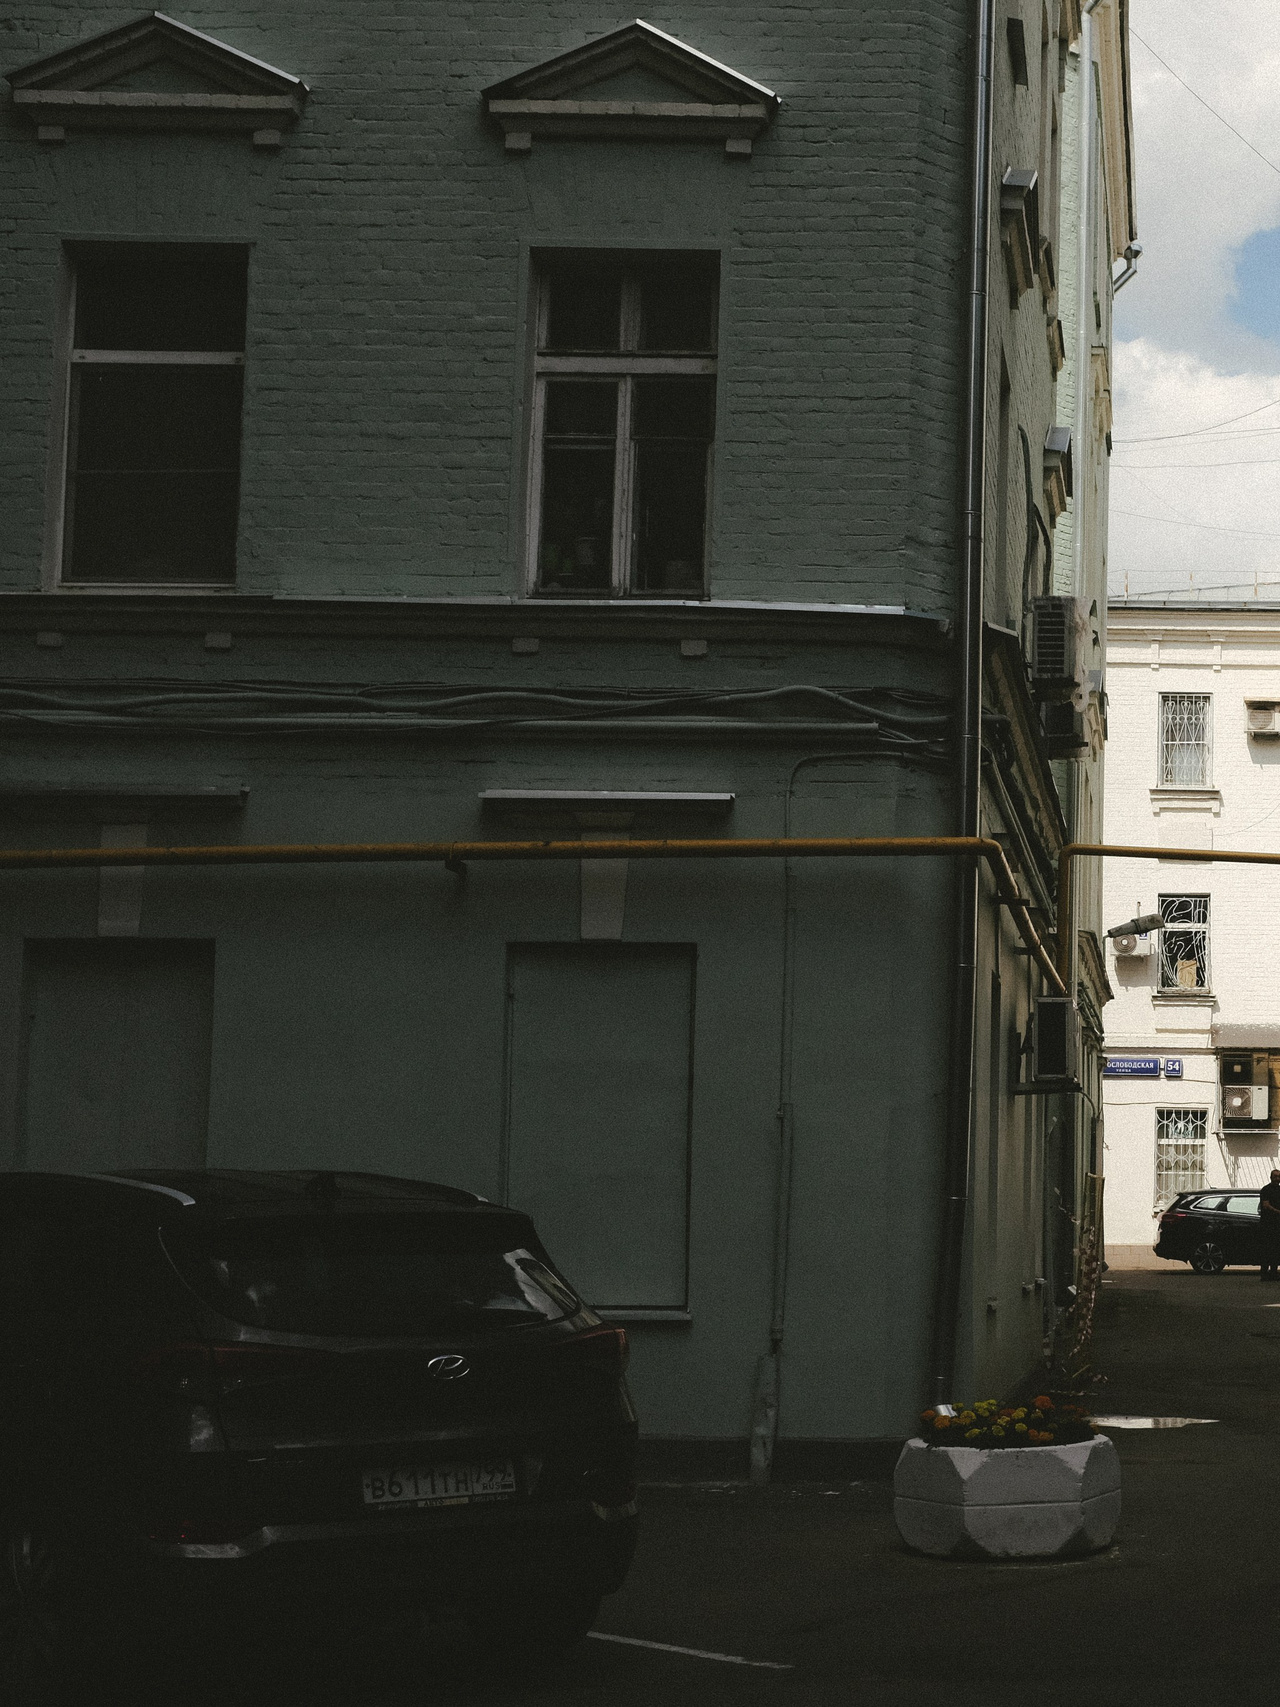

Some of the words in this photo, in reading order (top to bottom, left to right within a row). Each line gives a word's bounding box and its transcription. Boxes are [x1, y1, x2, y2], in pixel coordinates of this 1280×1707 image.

[1106, 1061, 1154, 1069] ОСЛОБОДСКАЯ
[1167, 1061, 1179, 1071] 54
[482, 1481, 501, 1490] RUS
